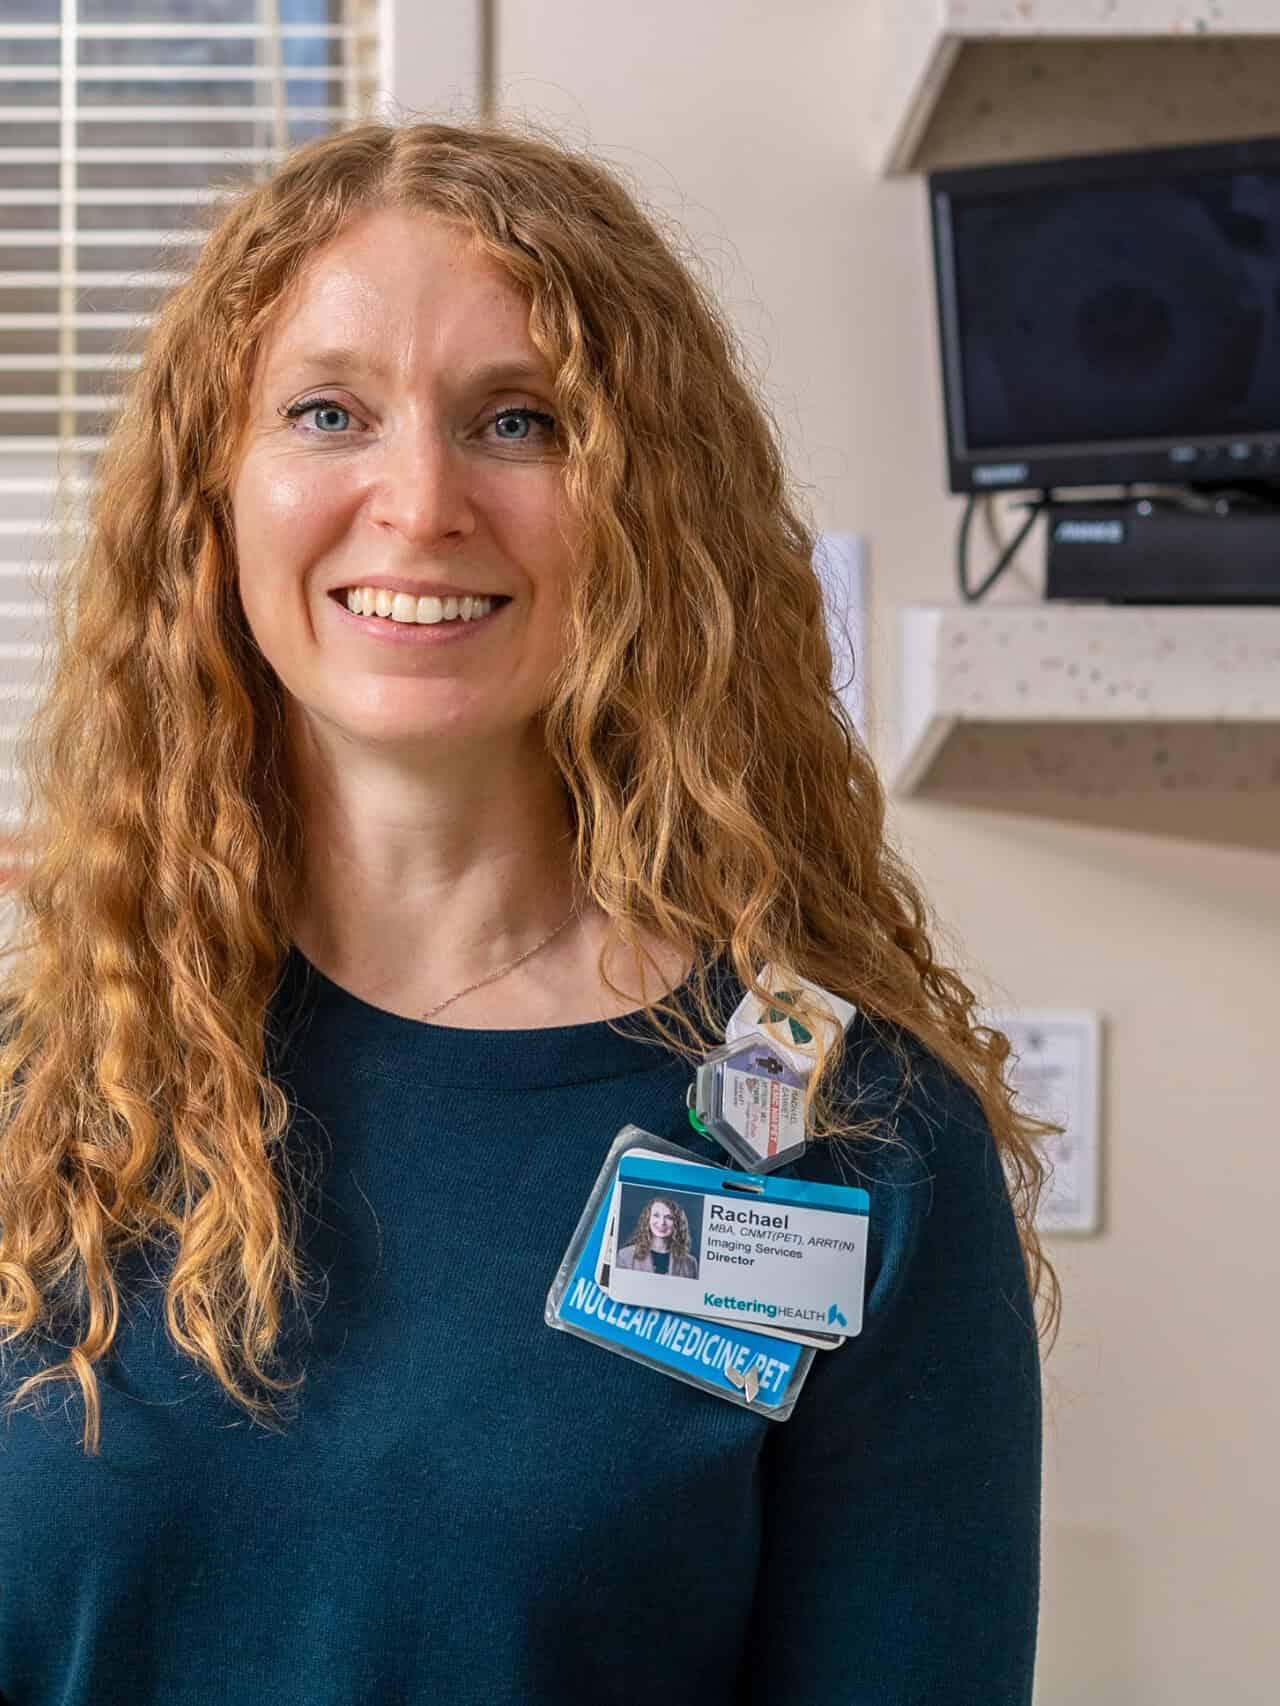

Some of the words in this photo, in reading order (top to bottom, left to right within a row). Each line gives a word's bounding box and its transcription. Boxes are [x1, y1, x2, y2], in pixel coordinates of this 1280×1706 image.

[710, 1204, 789, 1230] Rachael
[707, 1237, 752, 1253] Imaging
[755, 1243, 803, 1260] Services
[807, 1236, 856, 1253] ARRT(N)
[706, 1250, 755, 1267] Director
[568, 1277, 660, 1341] NUCLEAR
